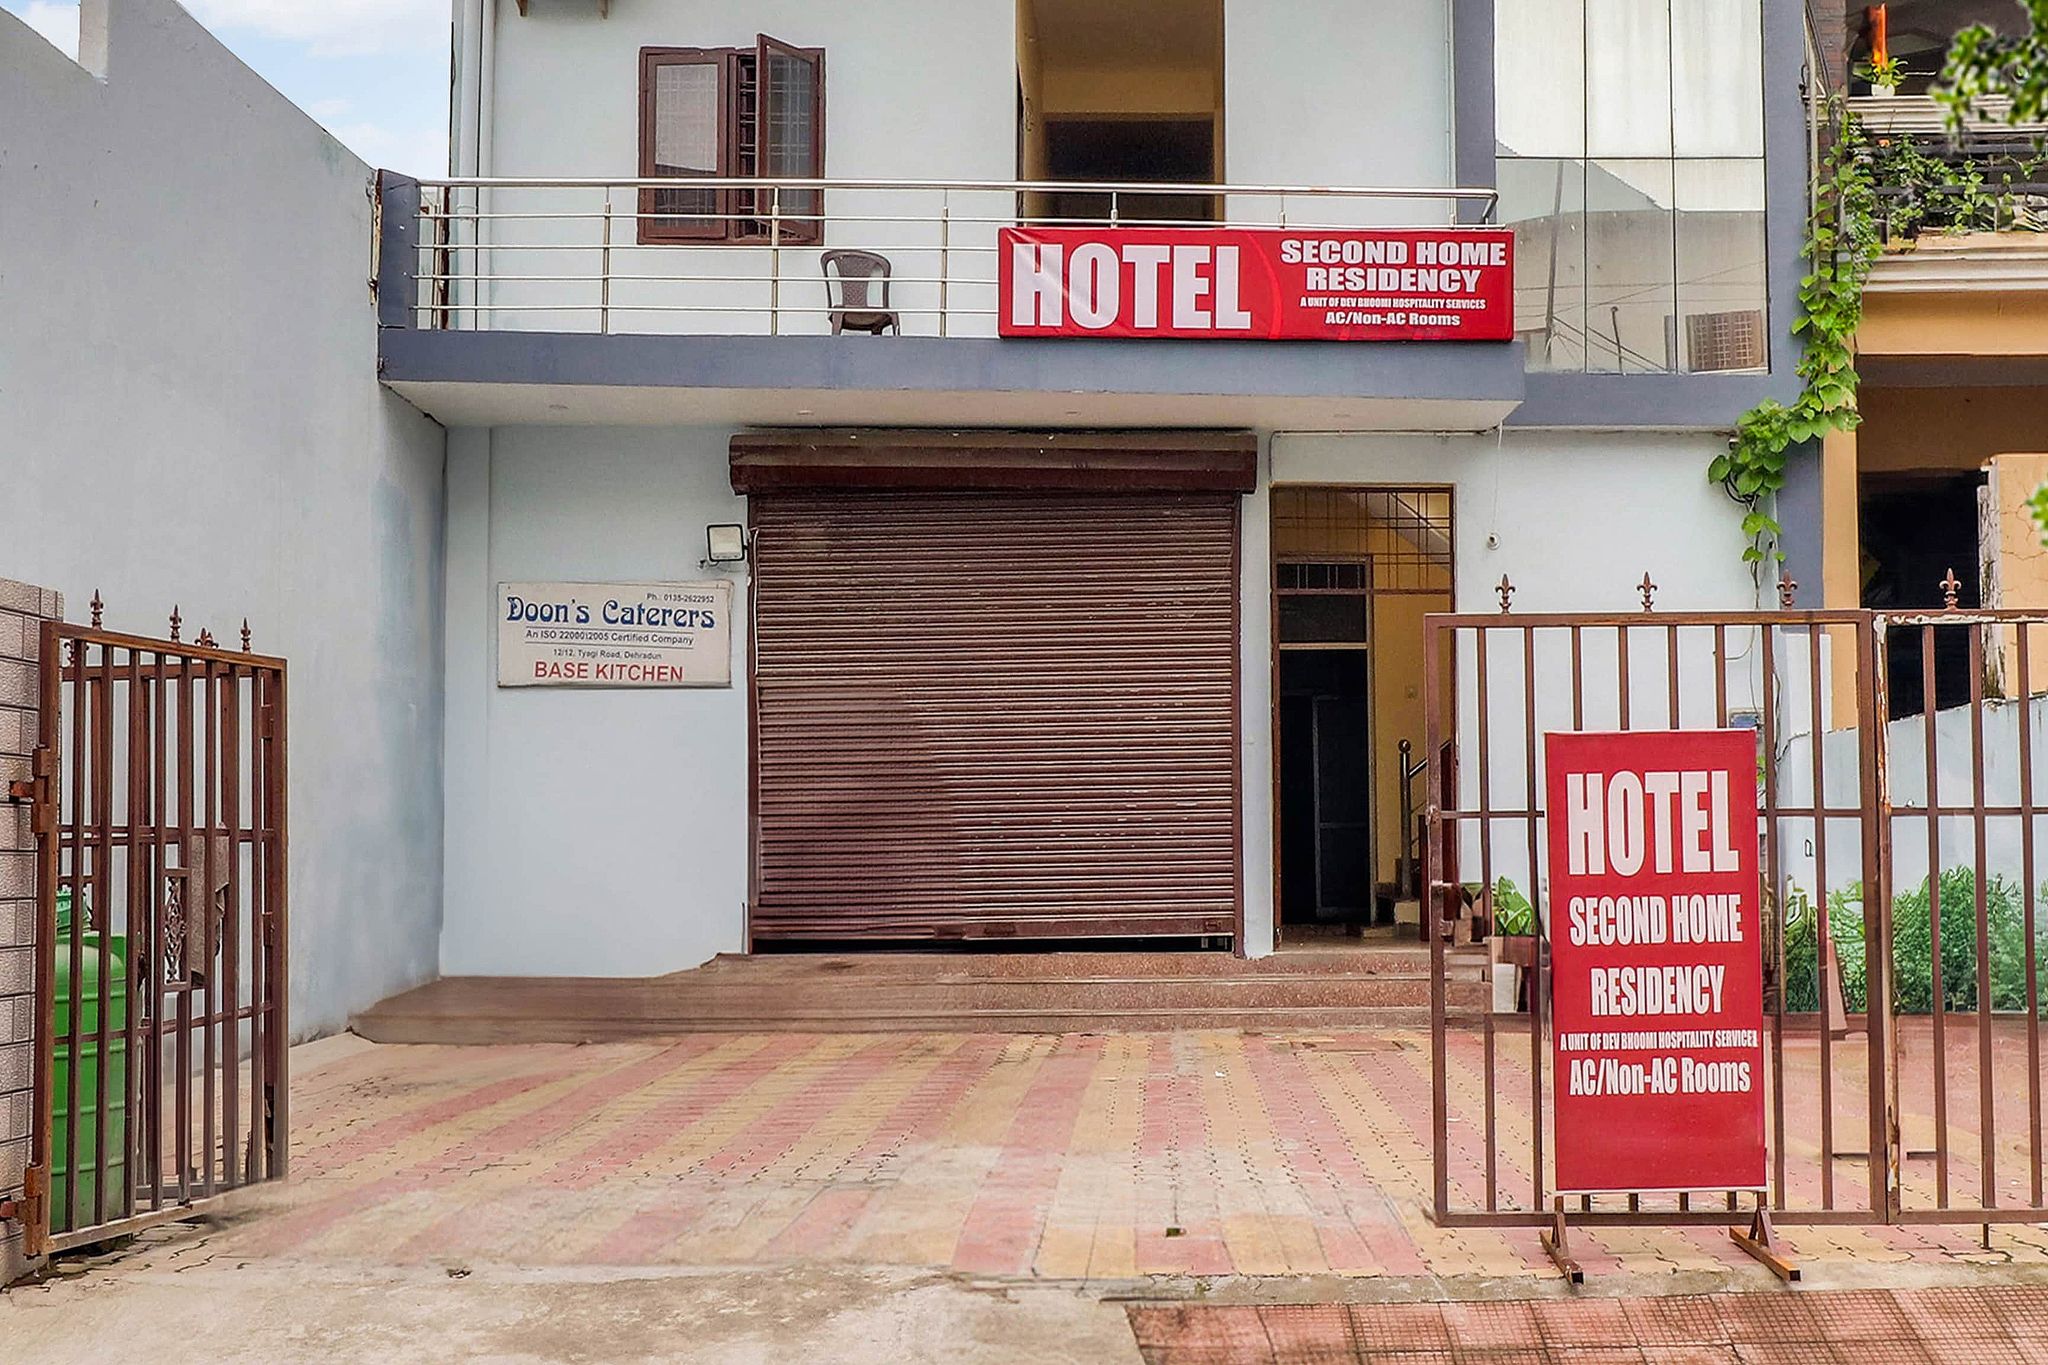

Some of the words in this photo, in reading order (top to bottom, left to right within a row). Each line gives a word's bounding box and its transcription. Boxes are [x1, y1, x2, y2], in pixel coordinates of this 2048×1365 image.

[1280, 239, 1408, 265] SECOND
[1415, 242, 1507, 266] HOME
[1011, 242, 1252, 330] HOTEL
[1306, 267, 1482, 293] RESIDENCY
[1299, 297, 1307, 307] A
[1308, 297, 1328, 307] UNIT
[1329, 297, 1340, 307] OF
[1340, 297, 1357, 308] DEV
[1358, 297, 1391, 308] BHOOMI
[1392, 298, 1445, 309] HOSPITALITY
[1446, 299, 1486, 310] SERVICES
[1325, 311, 1406, 326] AC/Non-AC
[1408, 312, 1461, 326] Rooms
[506, 596, 590, 624] Doon's
[602, 600, 715, 629] Caterers
[525, 630, 539, 639] An
[540, 630, 557, 639] ISO
[611, 632, 649, 643] Certified
[651, 633, 694, 646] Company
[578, 649, 598, 659] Tyagi
[624, 651, 662, 660] Dehradun
[534, 661, 589, 679] BASE
[596, 663, 684, 682] KITCHEN
[1566, 770, 1740, 877] HOTEL
[1569, 895, 1666, 946] SECOND
[1672, 893, 1744, 944] HOME
[1590, 965, 1726, 1016] RESIDENCY
[1560, 1033, 1567, 1050] A
[1567, 1033, 1589, 1050] UNIT
[1590, 1033, 1602, 1050] OF
[1602, 1032, 1620, 1050] DEV
[1621, 1031, 1657, 1050] BHOOMI
[1658, 1030, 1715, 1049] HOSPITALITY
[1569, 1056, 1677, 1096] AC/Non-AC
[1681, 1056, 1752, 1094] Rooms
